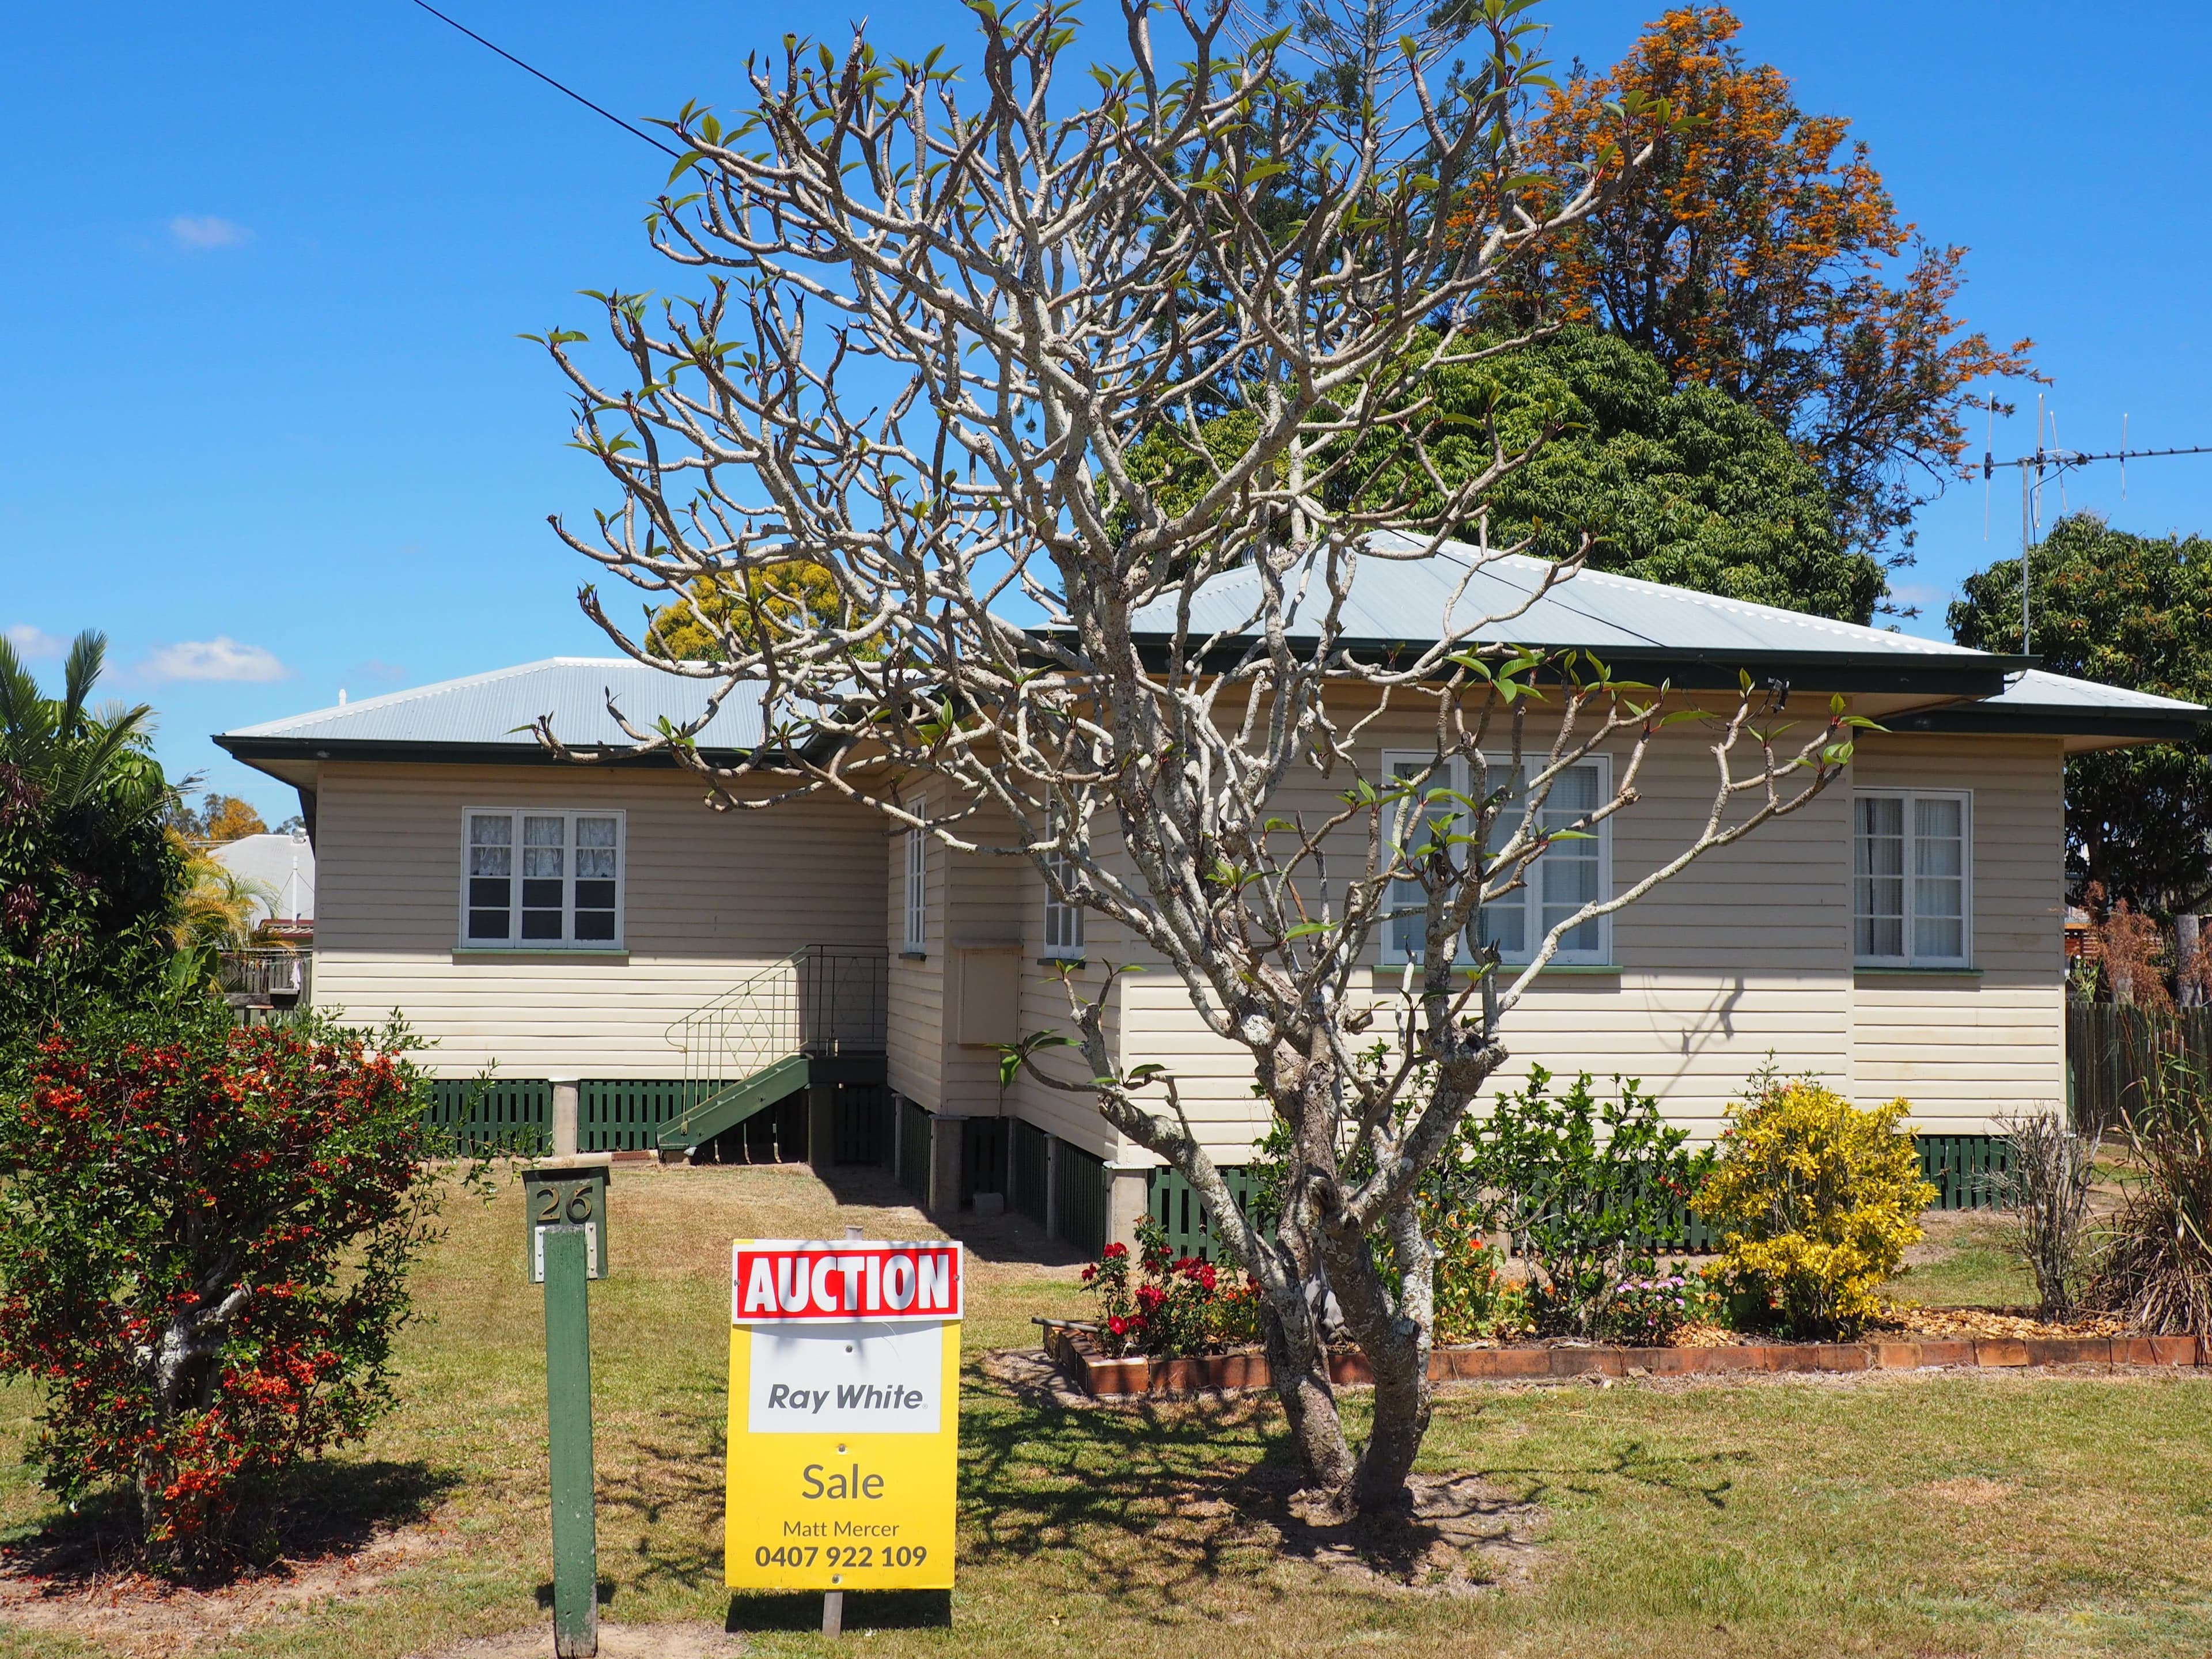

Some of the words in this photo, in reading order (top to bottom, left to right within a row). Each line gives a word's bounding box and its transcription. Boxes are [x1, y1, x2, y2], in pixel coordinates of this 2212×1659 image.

[536, 1185, 593, 1225] 26
[744, 1254, 949, 1313] AUCTION
[768, 1384, 830, 1414] Ray
[837, 1384, 923, 1409] White
[801, 1463, 884, 1499] Sale
[783, 1521, 827, 1537] Matt
[834, 1521, 900, 1537] Mercer
[755, 1546, 819, 1567] 0407
[826, 1546, 873, 1567] 922
[882, 1546, 927, 1567] 109
